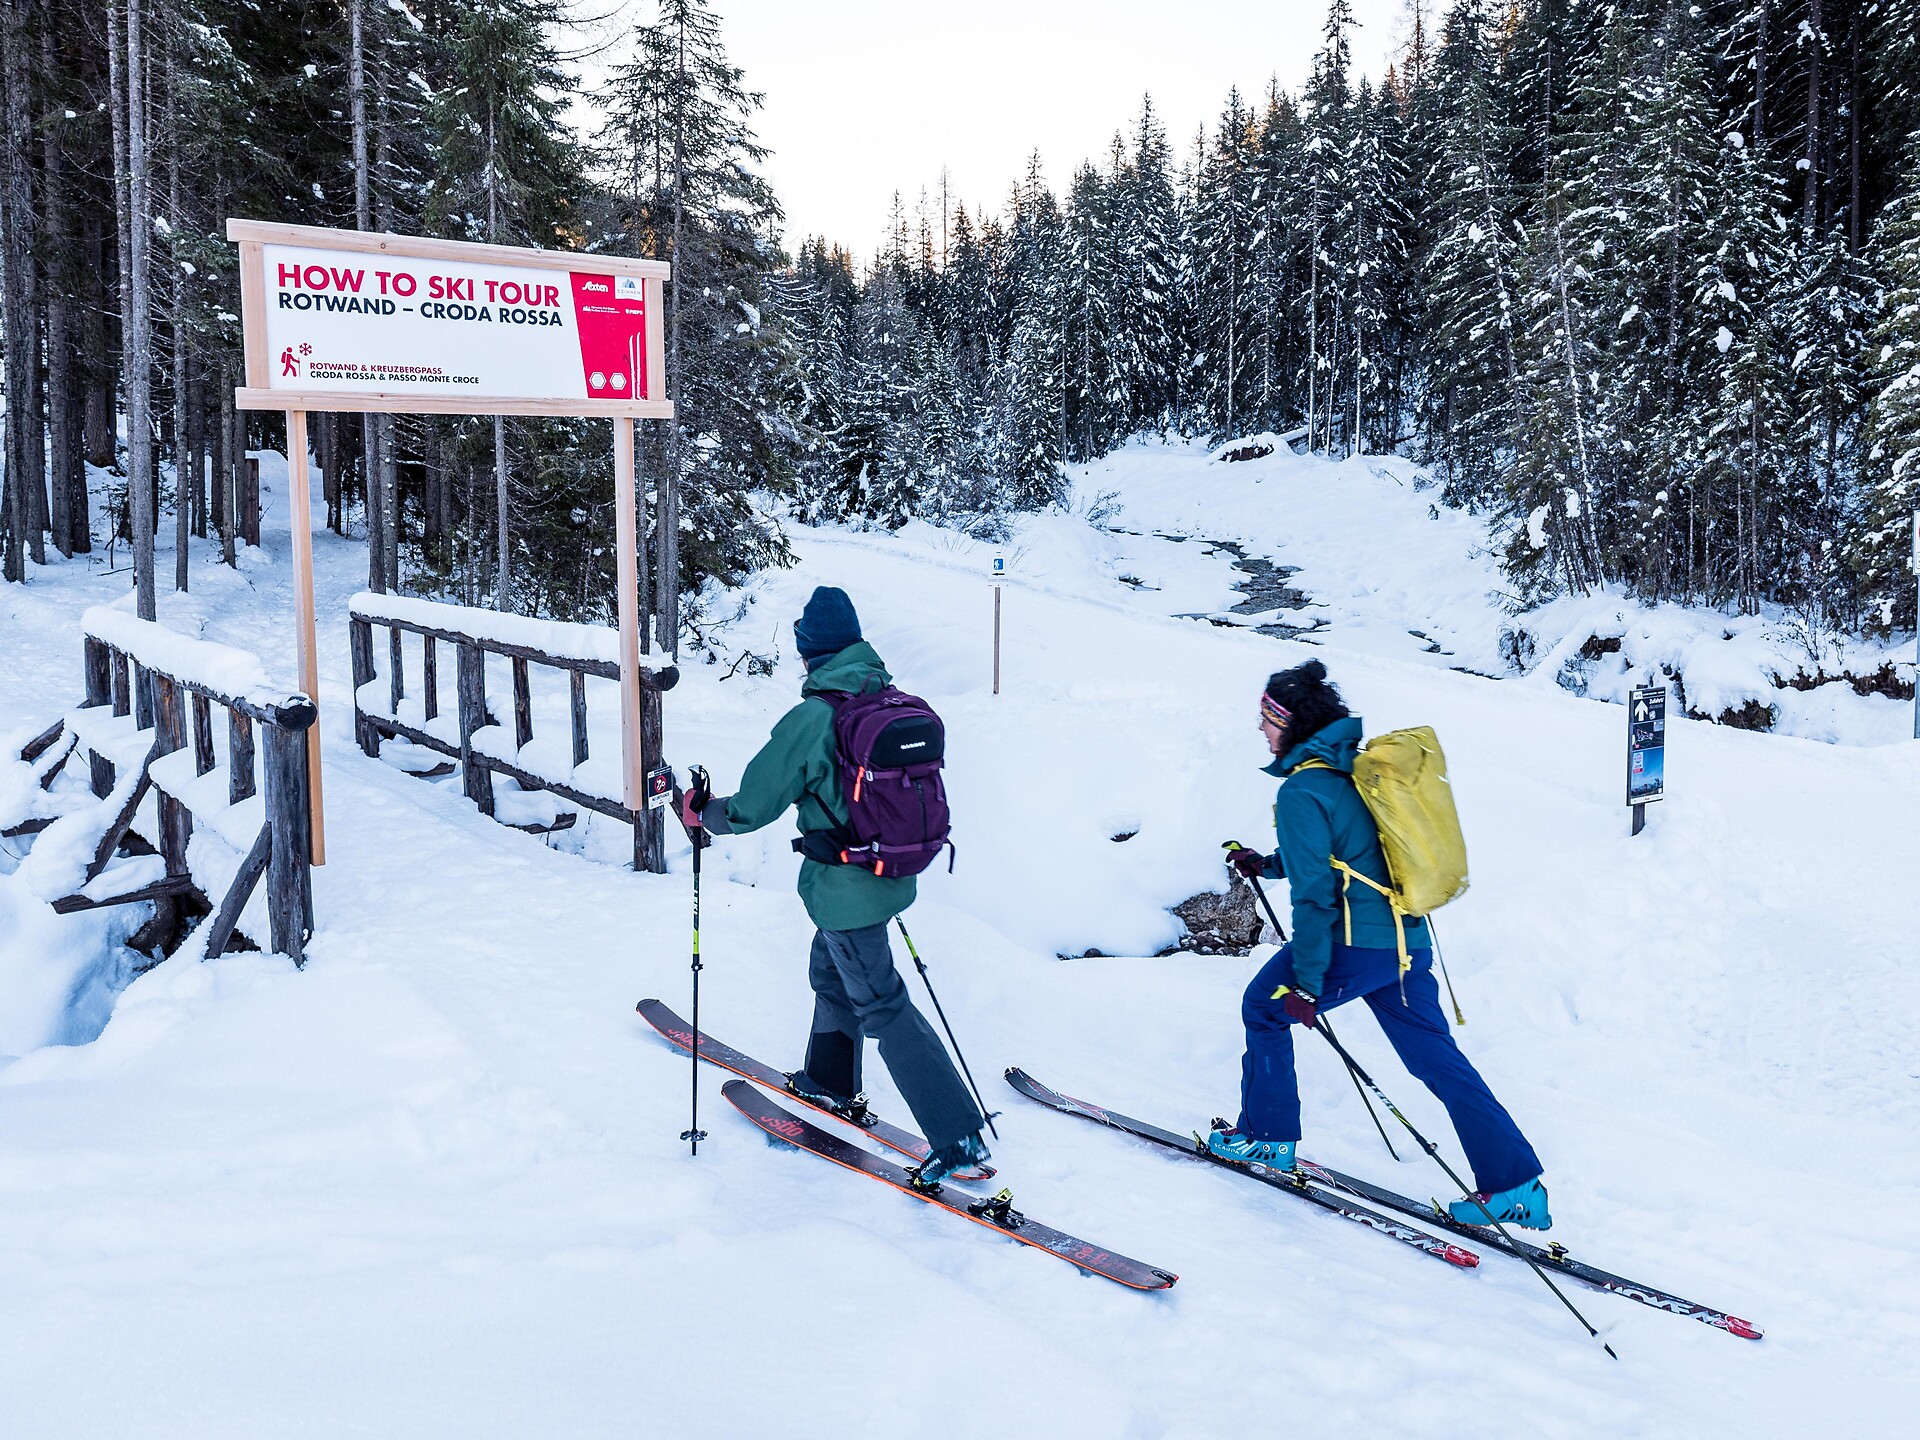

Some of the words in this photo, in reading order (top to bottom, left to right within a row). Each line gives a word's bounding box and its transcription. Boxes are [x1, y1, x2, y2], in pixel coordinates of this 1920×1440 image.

[278, 263, 365, 292] HOW
[375, 271, 417, 297] TO
[429, 275, 474, 301] SKI
[484, 281, 561, 307] TOUR
[279, 292, 396, 315] ROTWAND
[420, 302, 492, 322] CRODA
[499, 307, 563, 327] ROSSA
[310, 362, 358, 371] ROTWAND
[361, 364, 367, 372] &
[370, 365, 443, 374] KREUZBERGPASS
[310, 371, 343, 379] CRODA
[346, 372, 376, 380] ROSSA
[378, 373, 386, 381] &
[389, 374, 417, 382] PASSO
[419, 375, 450, 383] MONTE
[452, 376, 479, 384] CROCE
[1214, 1142, 1240, 1155] SCARPA
